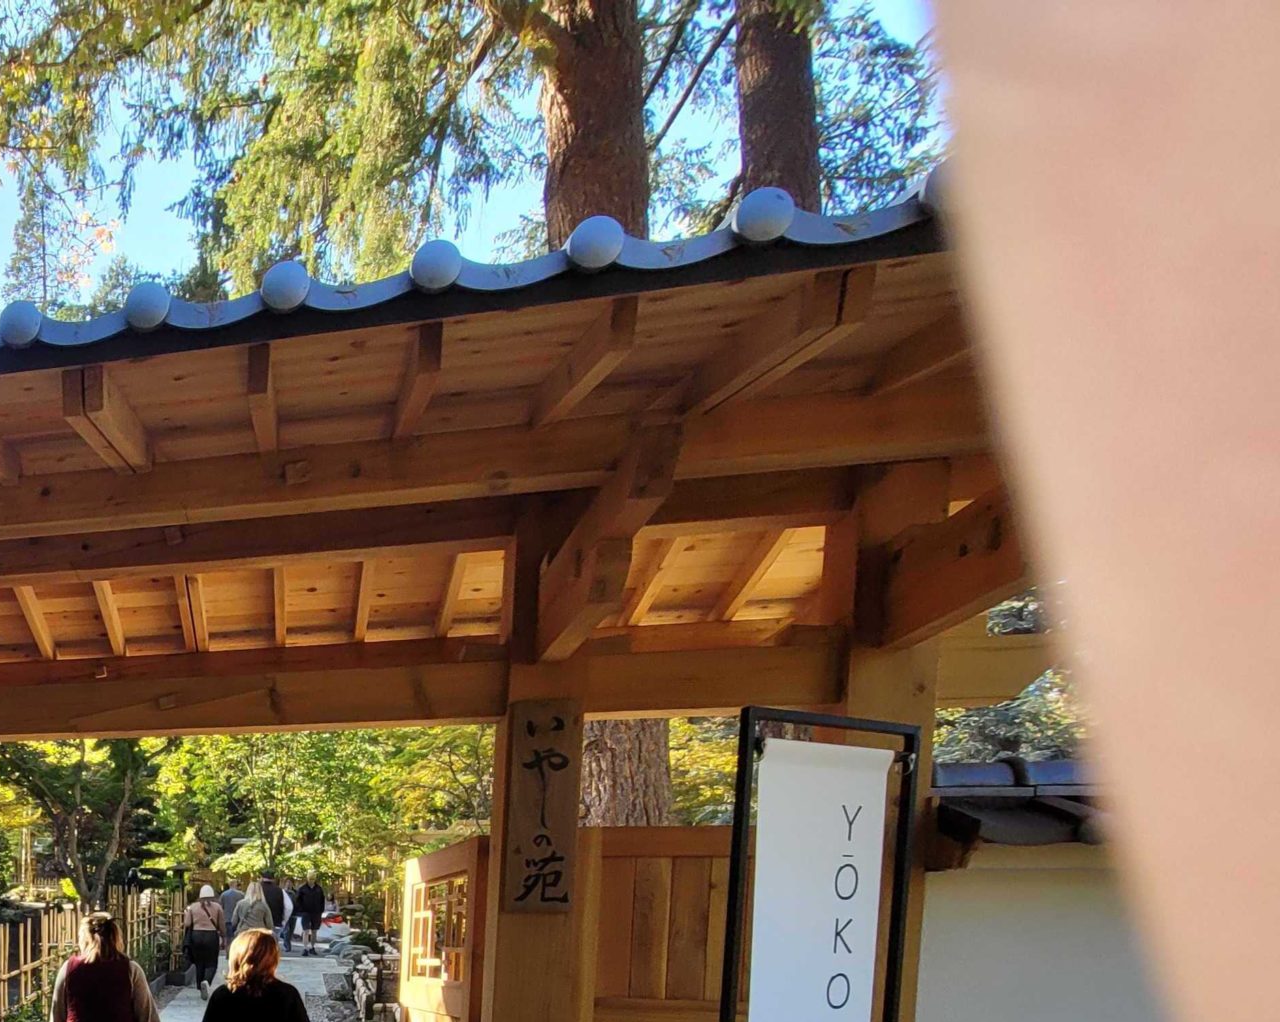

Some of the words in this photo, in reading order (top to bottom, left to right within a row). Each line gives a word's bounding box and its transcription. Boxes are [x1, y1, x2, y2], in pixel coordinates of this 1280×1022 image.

[514, 716, 570, 904] いやしの苑
